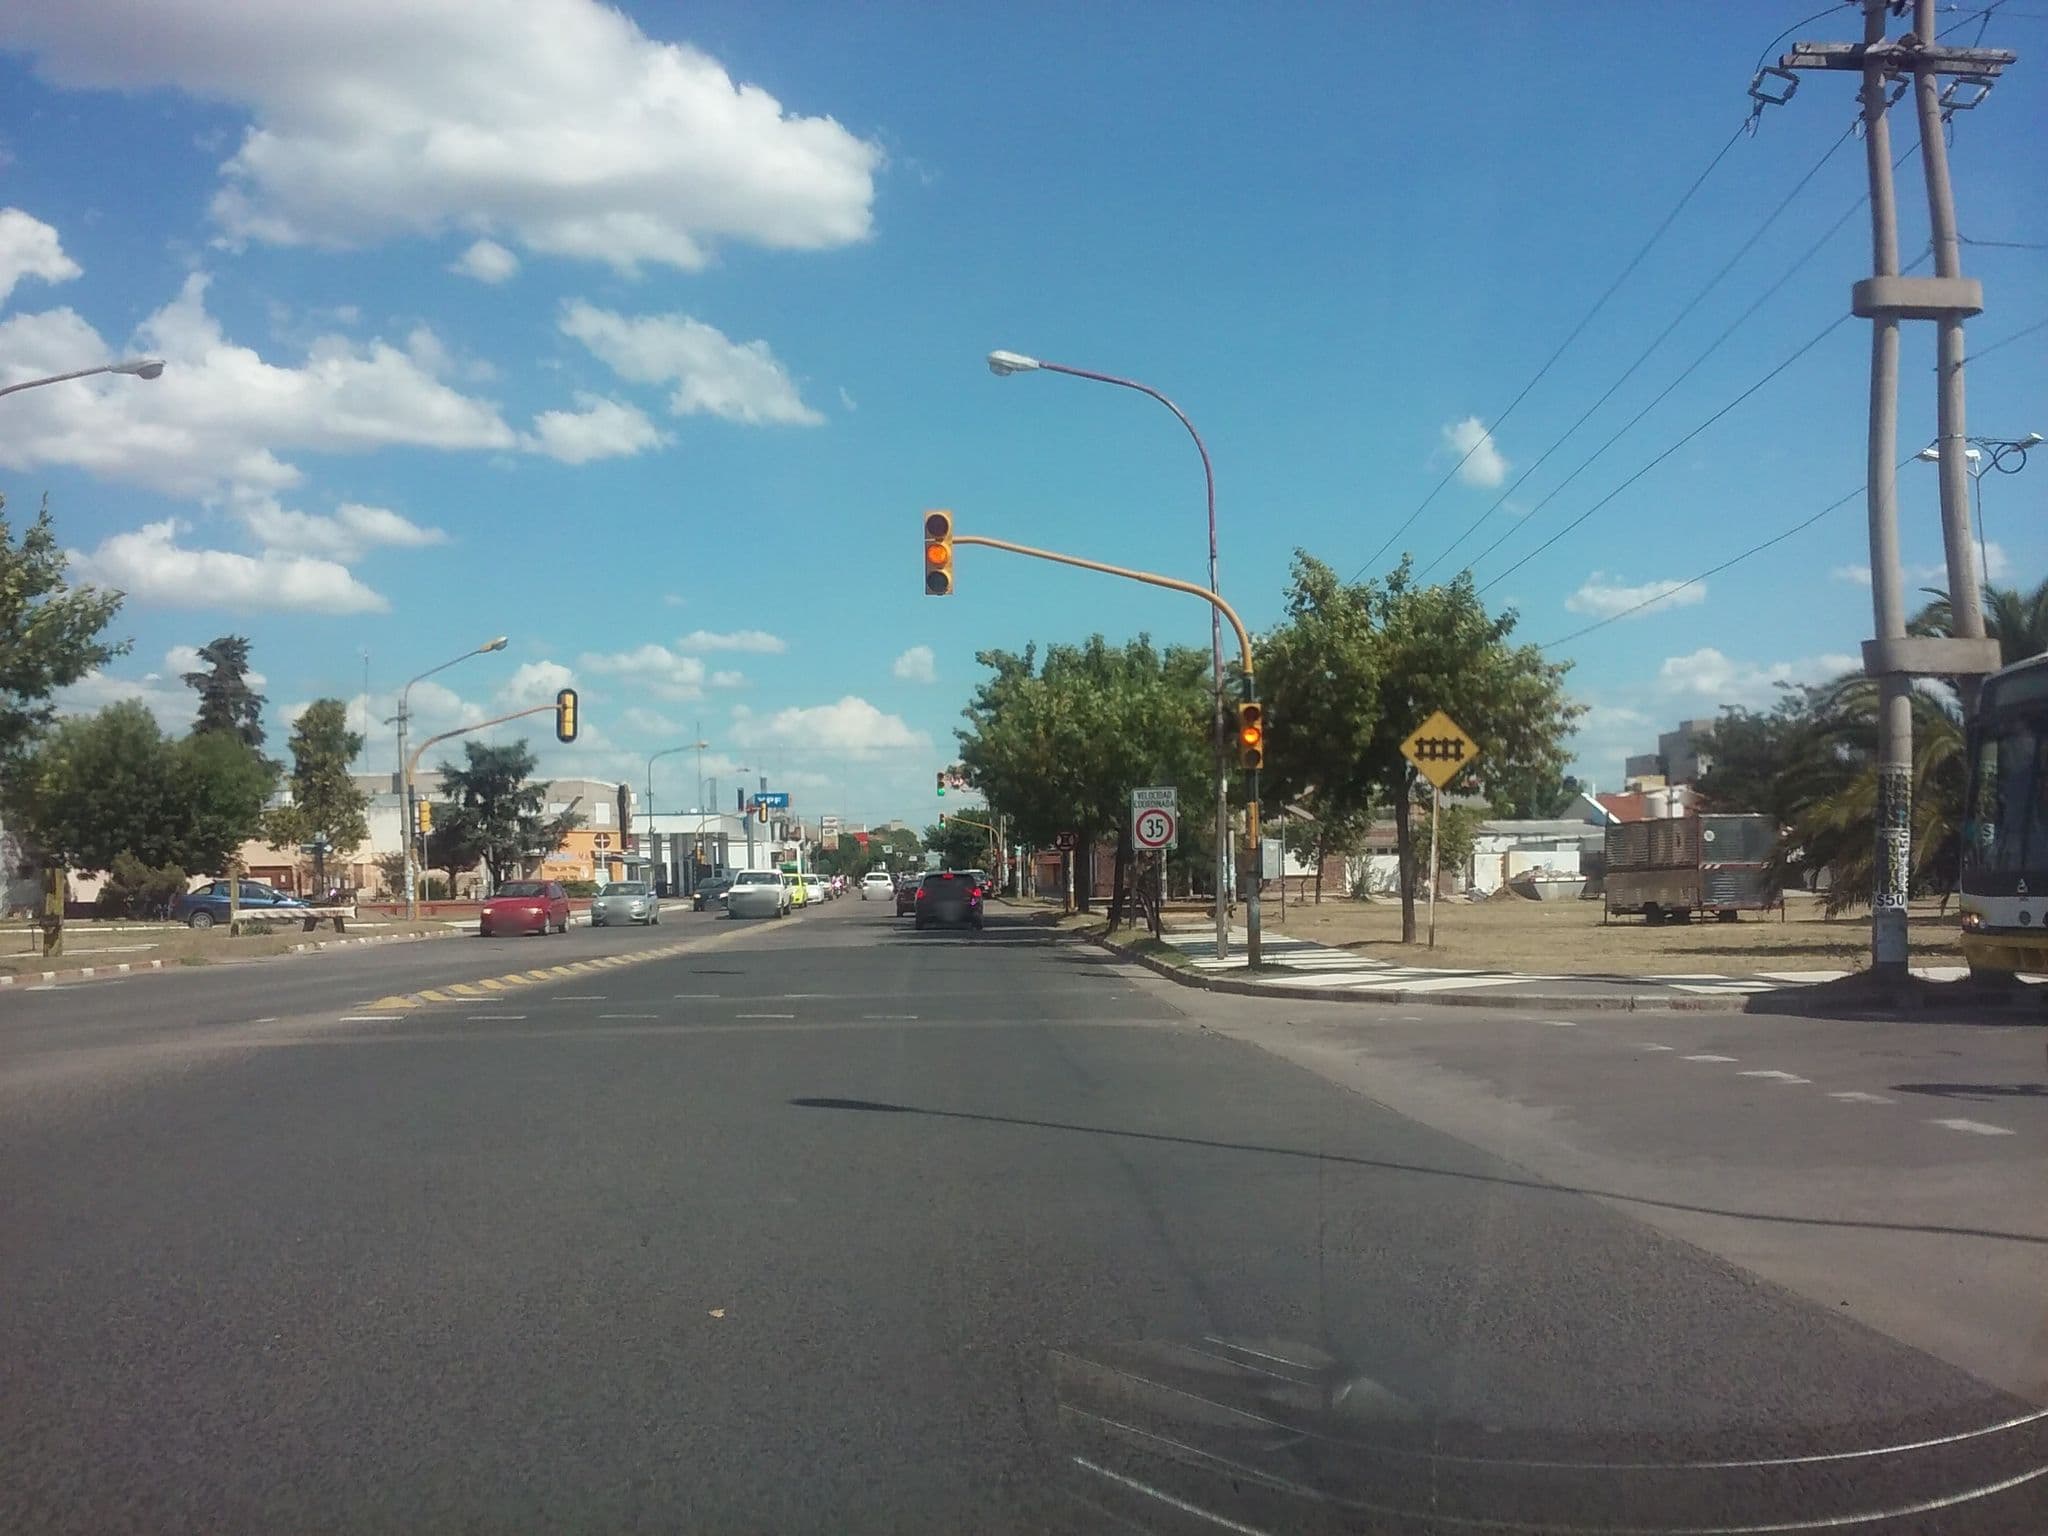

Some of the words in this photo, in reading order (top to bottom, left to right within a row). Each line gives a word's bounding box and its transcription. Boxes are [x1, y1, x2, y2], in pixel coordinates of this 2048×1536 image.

[1136, 791, 1172, 799] VELOCIDAD
[1146, 819, 1163, 838] 35
[1876, 894, 1905, 907] $50
